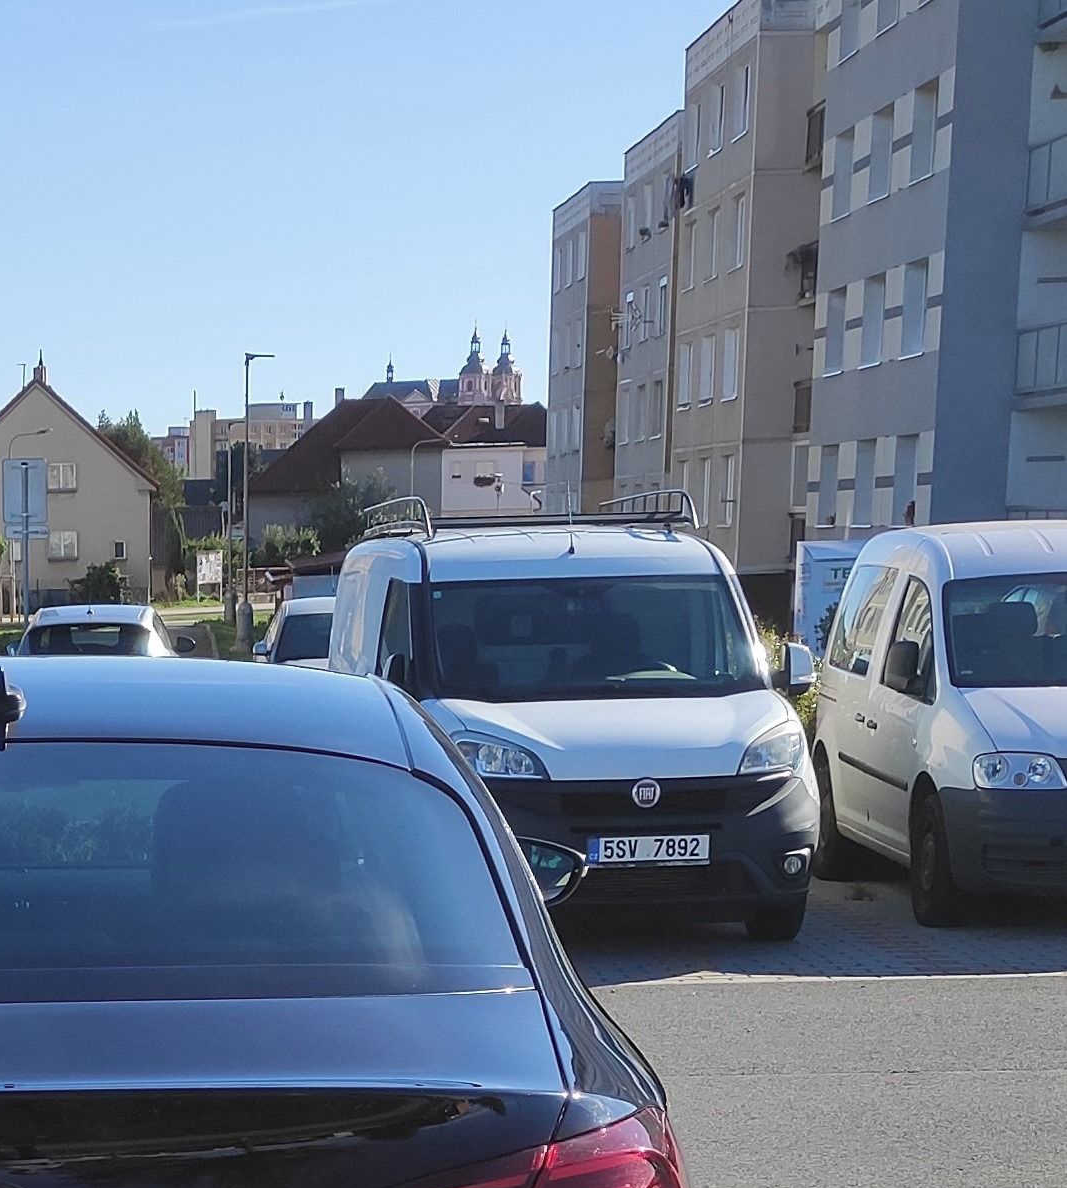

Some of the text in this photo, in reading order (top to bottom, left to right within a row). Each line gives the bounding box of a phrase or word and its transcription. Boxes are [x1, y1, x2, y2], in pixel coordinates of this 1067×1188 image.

[639, 787, 655, 800] FIAT
[603, 838, 700, 859] 5SV 7892
